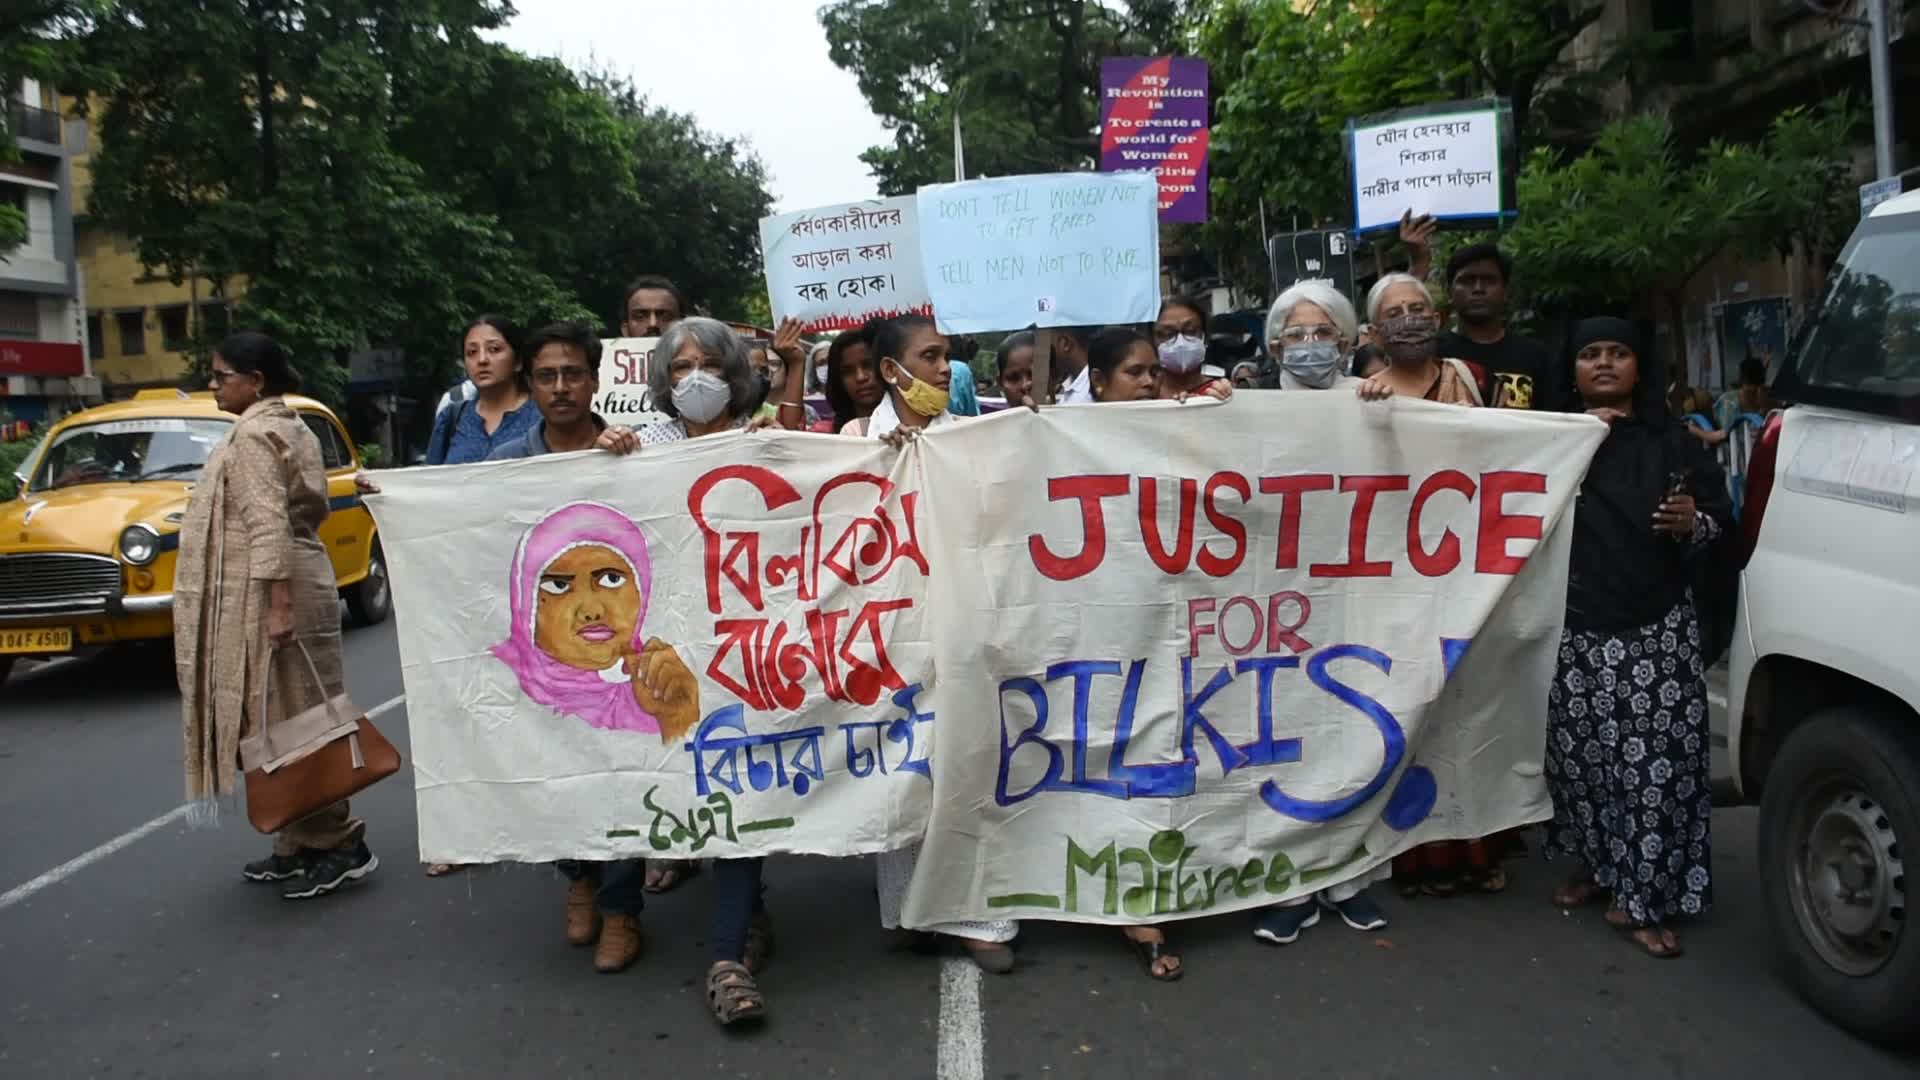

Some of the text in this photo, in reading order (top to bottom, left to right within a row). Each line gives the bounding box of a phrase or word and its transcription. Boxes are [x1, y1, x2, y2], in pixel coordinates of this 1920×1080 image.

[1142, 75, 1170, 88] My
[1106, 87, 1204, 98] Revolution
[1148, 99, 1164, 109] is
[1108, 117, 1201, 128] To create a
[1114, 134, 1197, 145] world for
[1121, 150, 1189, 161] Women
[1400, 149, 1447, 166] শিকার
[1151, 166, 1197, 177] Girls
[1157, 183, 1196, 193] rom
[1362, 168, 1492, 198] নারীর পাশে দাঁড়ান
[993, 187, 1032, 214] TELL
[1050, 185, 1105, 210] WOMEN
[1109, 183, 1143, 202] NOT
[791, 208, 901, 238] ধর্ষণকারীদের
[977, 212, 1097, 240] TO GET RAPED
[792, 241, 893, 271] আড়াল করা
[939, 247, 1141, 285] TELL MEN NOT TO RAPE
[794, 282, 828, 302] বন্ধ
[1028, 470, 1548, 581] JUSTICE
[1187, 590, 1313, 658] FOR
[684, 682, 935, 796] বিচার চাই
